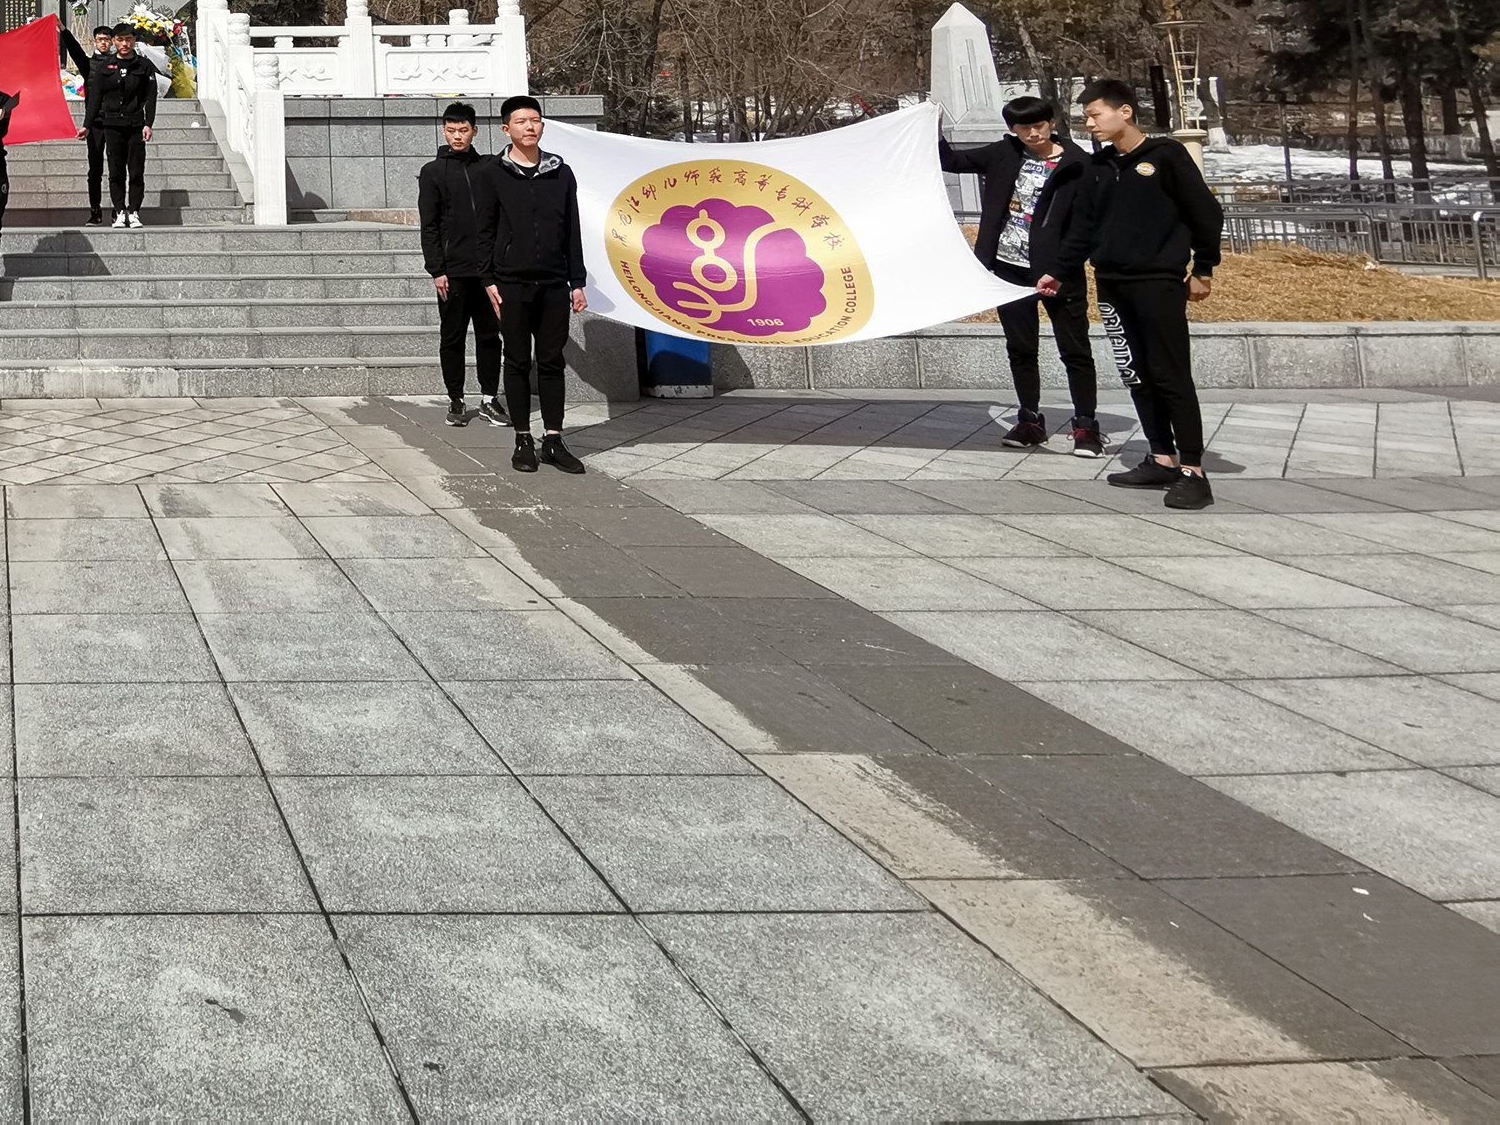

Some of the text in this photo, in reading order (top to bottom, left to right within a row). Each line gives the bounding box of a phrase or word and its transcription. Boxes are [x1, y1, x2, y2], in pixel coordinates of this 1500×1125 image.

[620, 260, 691, 330] HEILONGJIANG
[793, 315, 853, 343] EDUCATION
[840, 266, 857, 314] COLLEGE
[747, 318, 784, 327] 1906
